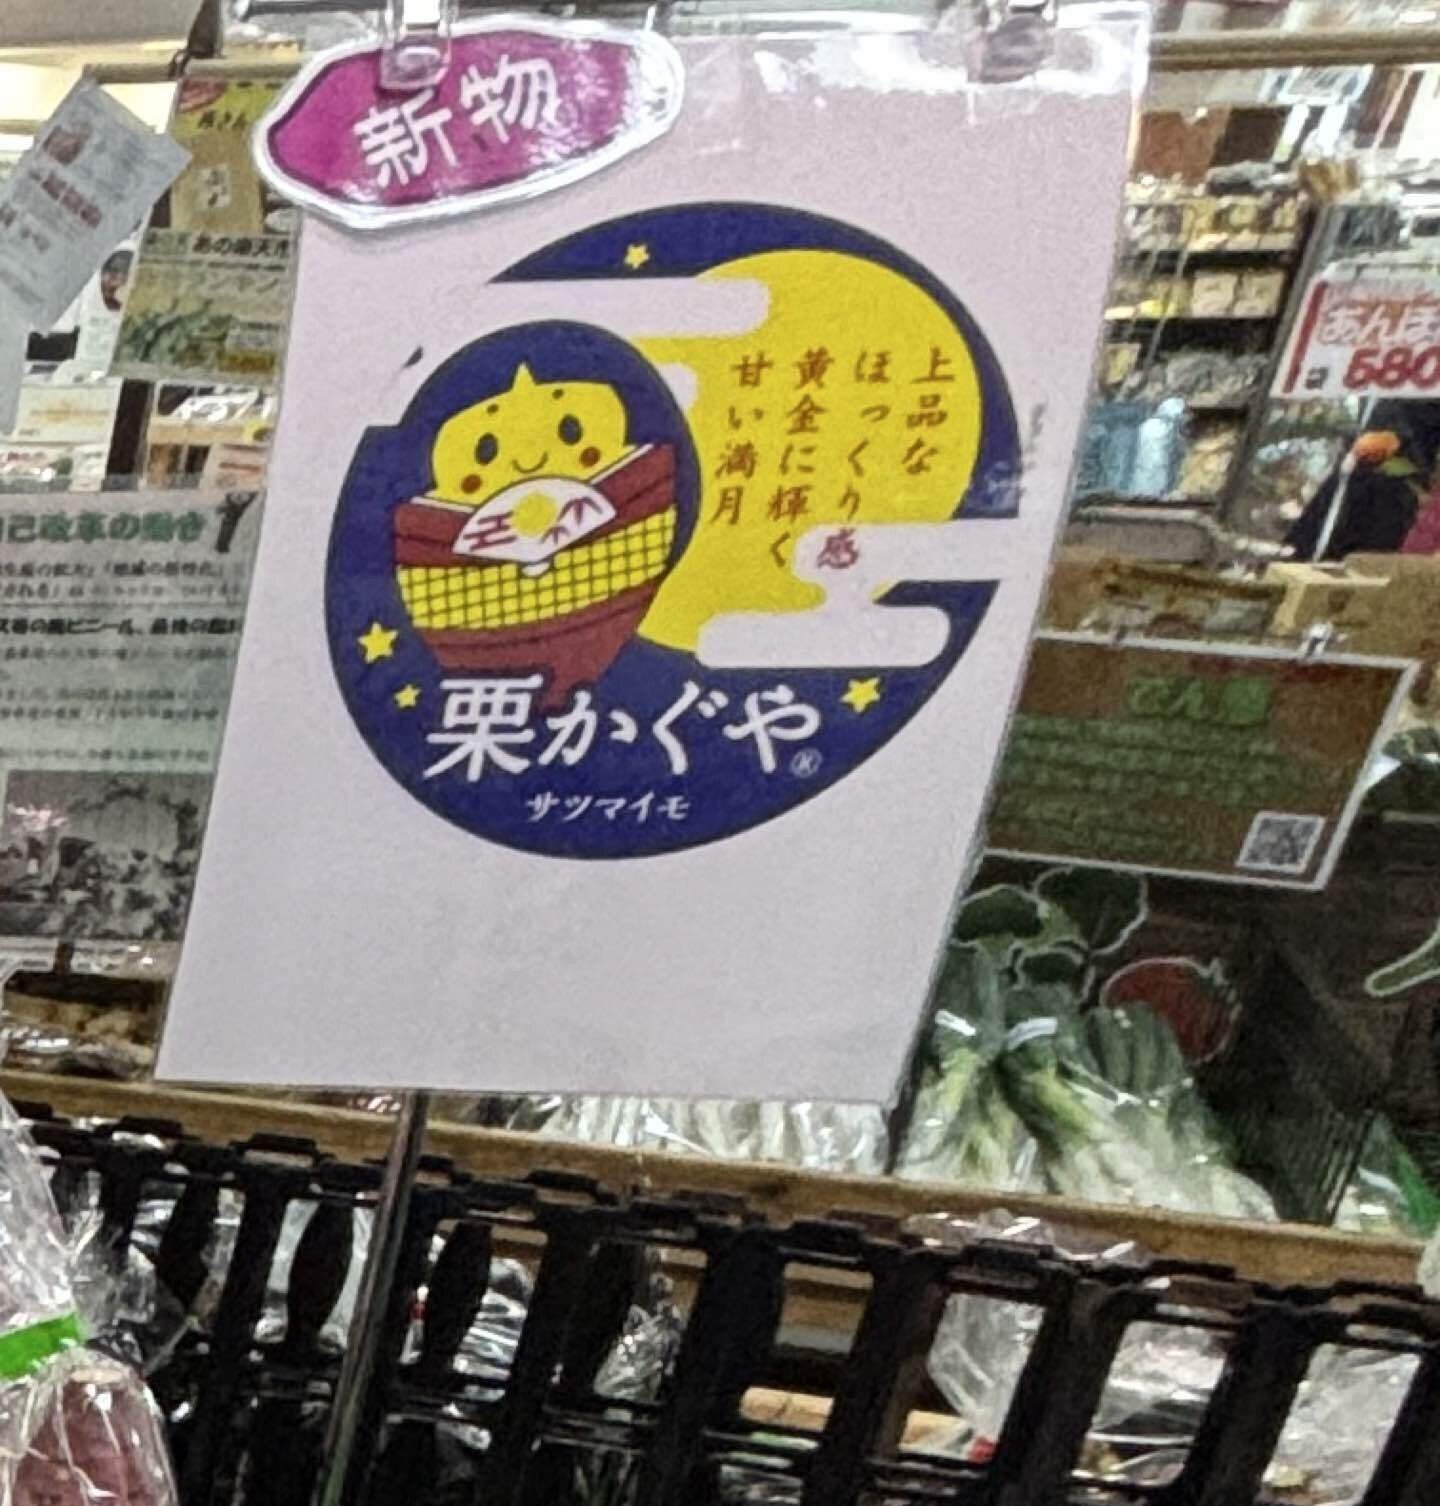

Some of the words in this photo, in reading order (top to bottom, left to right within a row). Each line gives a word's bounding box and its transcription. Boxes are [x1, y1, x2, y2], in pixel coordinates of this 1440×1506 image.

[352, 55, 560, 189] 新物
[711, 352, 774, 526] 甘い満月
[766, 349, 837, 570] 黄金に輝く
[816, 351, 892, 570] ほっくり感
[897, 347, 957, 478] 上品な
[423, 673, 823, 782] 栗かぐや
[526, 789, 691, 824] サツマイモ
